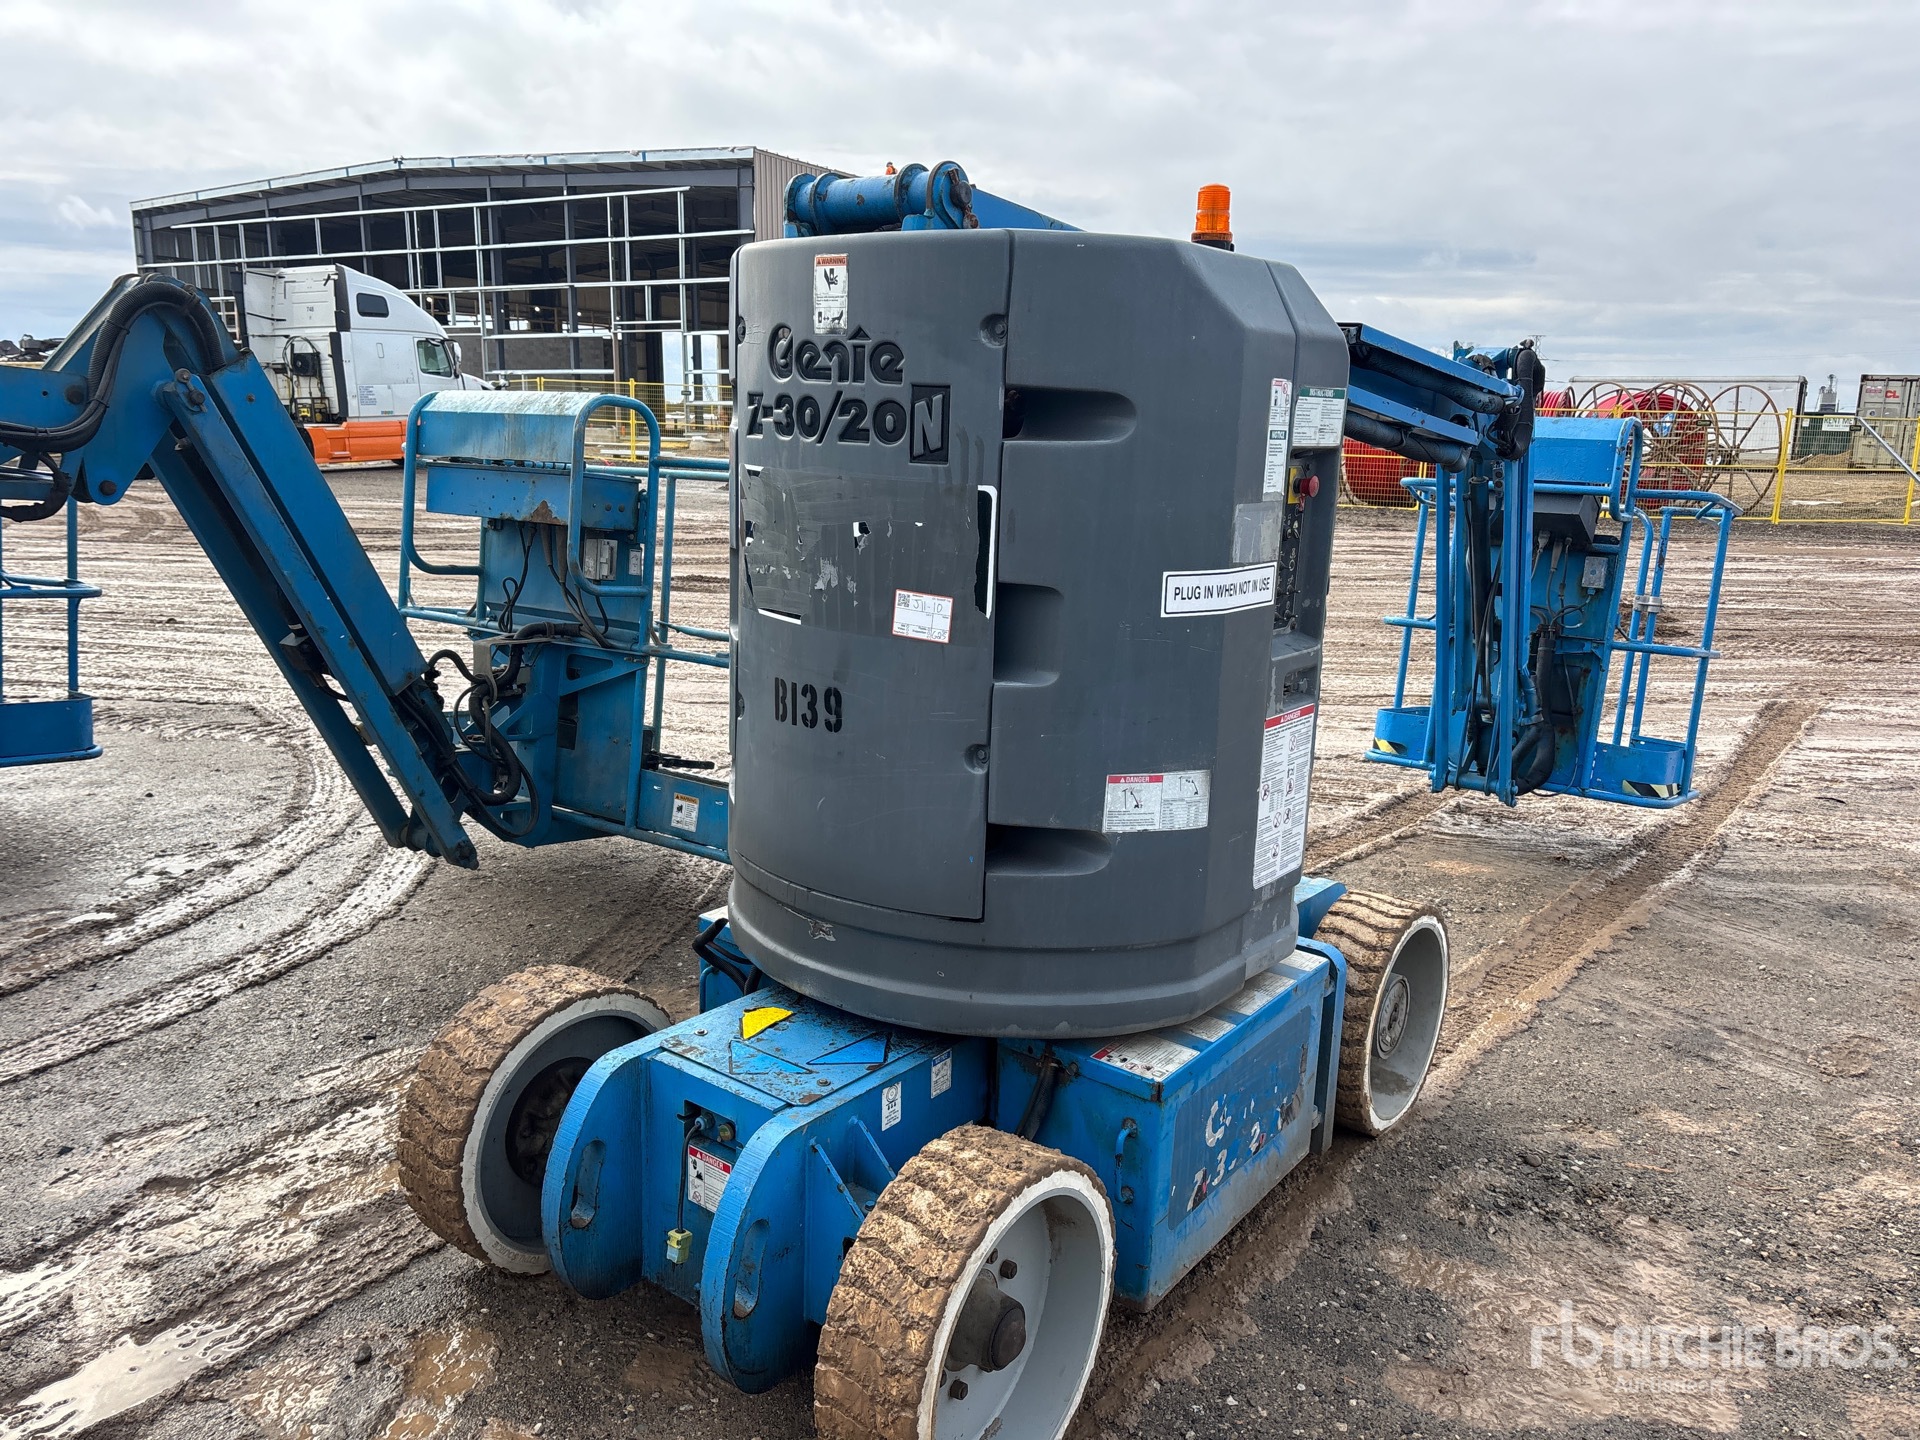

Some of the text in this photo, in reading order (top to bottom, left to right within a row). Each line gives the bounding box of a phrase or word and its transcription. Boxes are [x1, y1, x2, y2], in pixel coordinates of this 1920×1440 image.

[821, 257, 846, 265] WARNING
[768, 324, 905, 385] Genie
[1173, 577, 1271, 601] PLUG IN WHEN NOT IN USE
[1283, 710, 1301, 722] DANGER
[701, 1153, 724, 1170] DANGER
